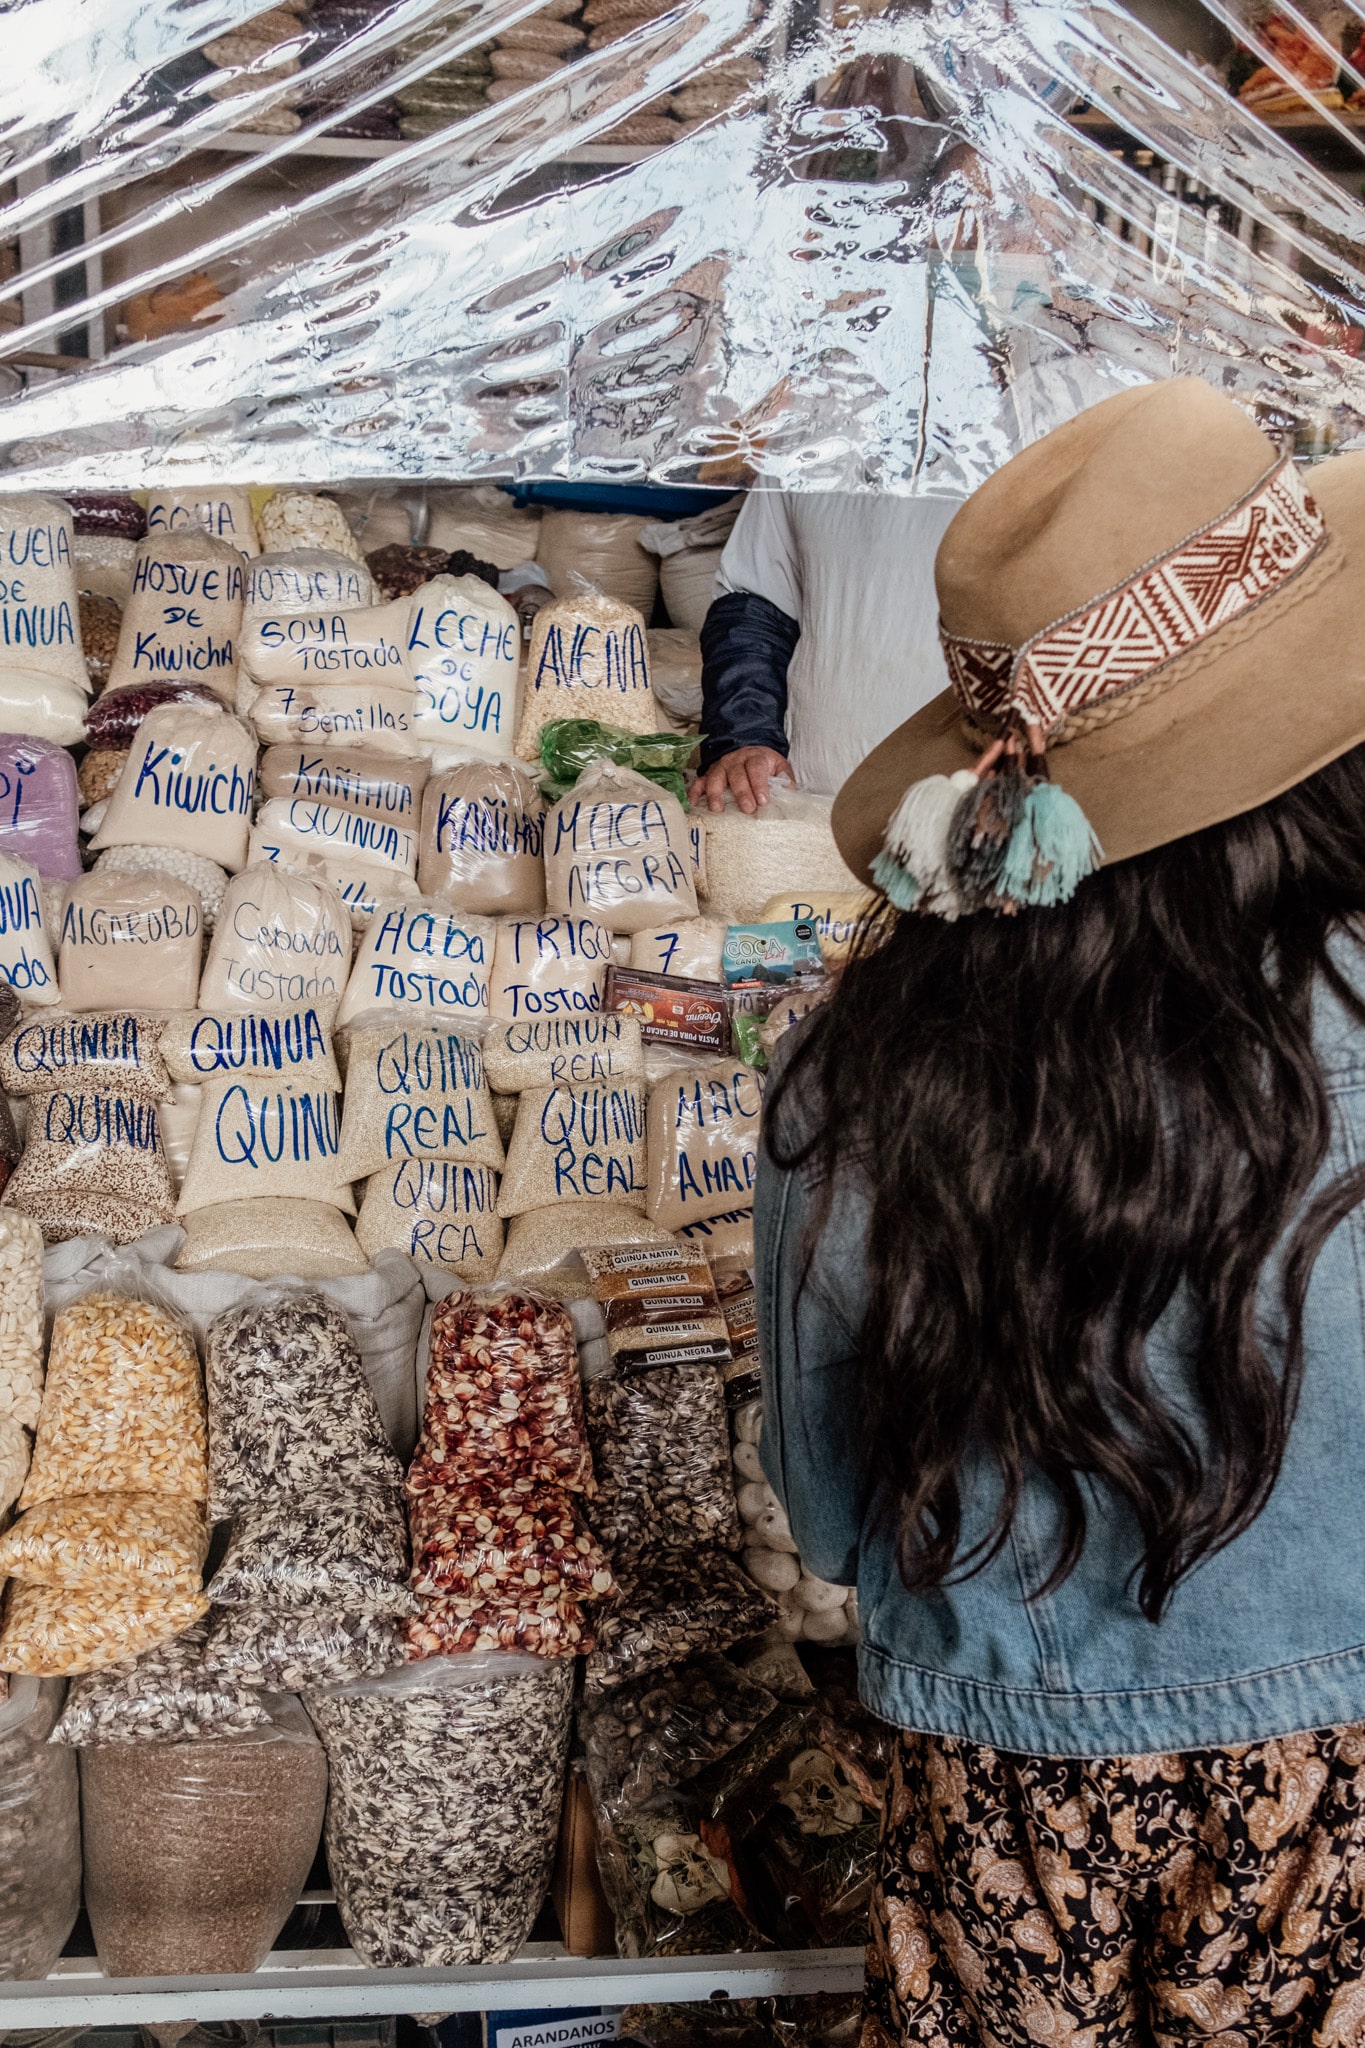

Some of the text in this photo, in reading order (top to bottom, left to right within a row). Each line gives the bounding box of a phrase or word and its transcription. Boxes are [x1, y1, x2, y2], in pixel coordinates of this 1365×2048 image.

[163, 607, 204, 627] DE
[260, 616, 348, 648] SOYA
[408, 607, 515, 661] LECHE
[535, 624, 648, 692] AVENA
[441, 660, 472, 681] DE
[276, 688, 295, 715] 7
[298, 704, 408, 733] Semillas
[554, 799, 670, 856] MACA
[568, 851, 688, 907] NEGRA
[234, 902, 343, 957] Cebada
[655, 933, 680, 973] 7
[725, 938, 783, 959] COCA
[735, 957, 762, 966] CANDY
[646, 1025, 669, 1037] CACAO
[670, 1029, 679, 1038] DE
[679, 1030, 697, 1041] PURA
[698, 1034, 720, 1045] PASTA
[551, 1052, 624, 1082] REAL
[385, 1097, 487, 1159] REAL
[554, 1148, 649, 1196] REAL
[614, 1249, 679, 1265] QUINUA NATIVA
[631, 1274, 687, 1286] QUINUA INCA
[644, 1296, 701, 1306] QUINUA ROJA
[646, 1322, 702, 1334] QUINUA REAL
[648, 1347, 712, 1362] QUINUA NEGRA
[511, 2020, 615, 2048] ARANDANOS
